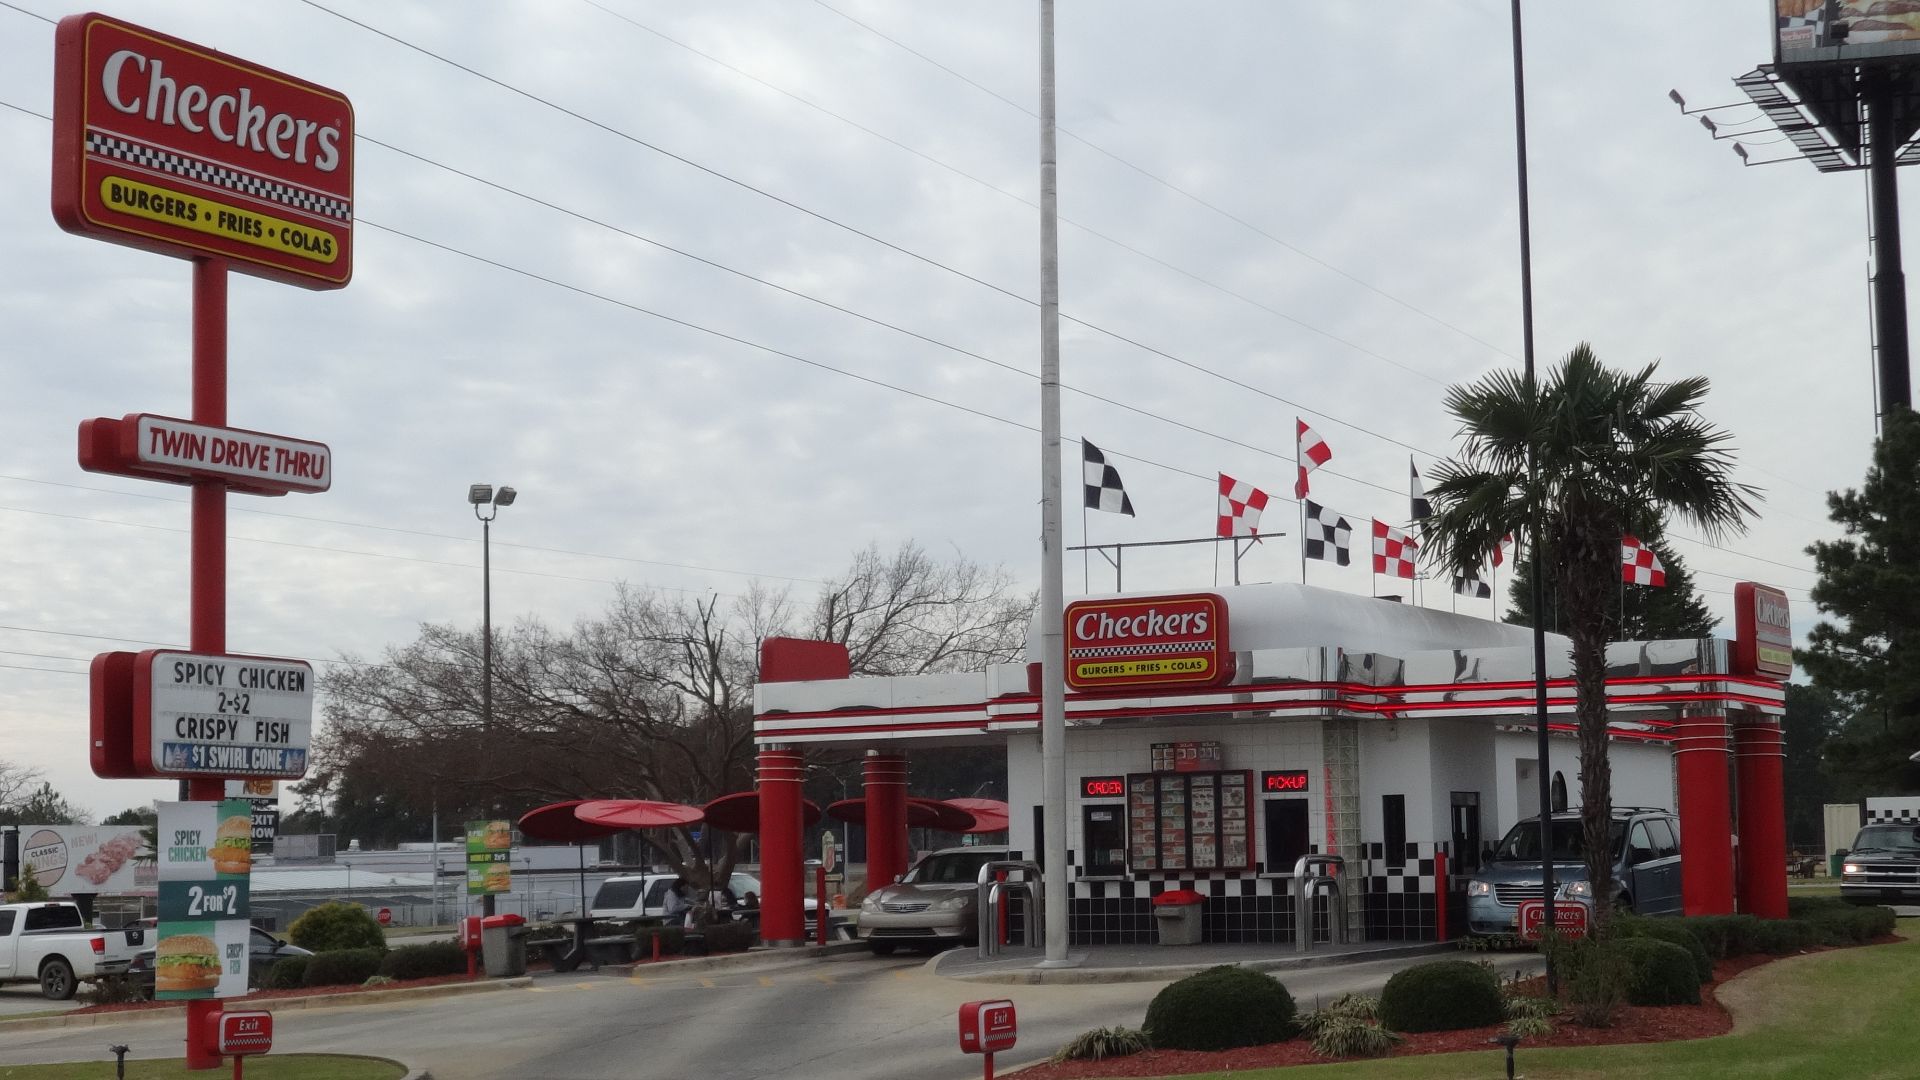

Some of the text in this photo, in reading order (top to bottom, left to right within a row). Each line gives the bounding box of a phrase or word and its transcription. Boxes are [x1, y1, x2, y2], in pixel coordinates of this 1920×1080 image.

[102, 49, 340, 172] Checkers
[110, 183, 332, 256] BURGERS FRIES COLAS
[150, 427, 325, 480] TWIN DRIVE THRU
[1075, 609, 1208, 641] Checkers
[174, 661, 305, 692] SPICY CHICKEN
[1082, 661, 1202, 675] BURGERS FRIES COLAS
[175, 717, 290, 743] CRISPY FISH
[192, 745, 282, 770] $1 SWIRL CONE
[1087, 780, 1122, 796] ORDER
[174, 830, 201, 846] SPICY
[31, 847, 59, 857] CLASSIC
[168, 847, 206, 862] CHICKEN
[188, 886, 202, 915] 2
[203, 895, 223, 911] FOR
[239, 1018, 259, 1031] Exit
[994, 1010, 1007, 1024] Exit
